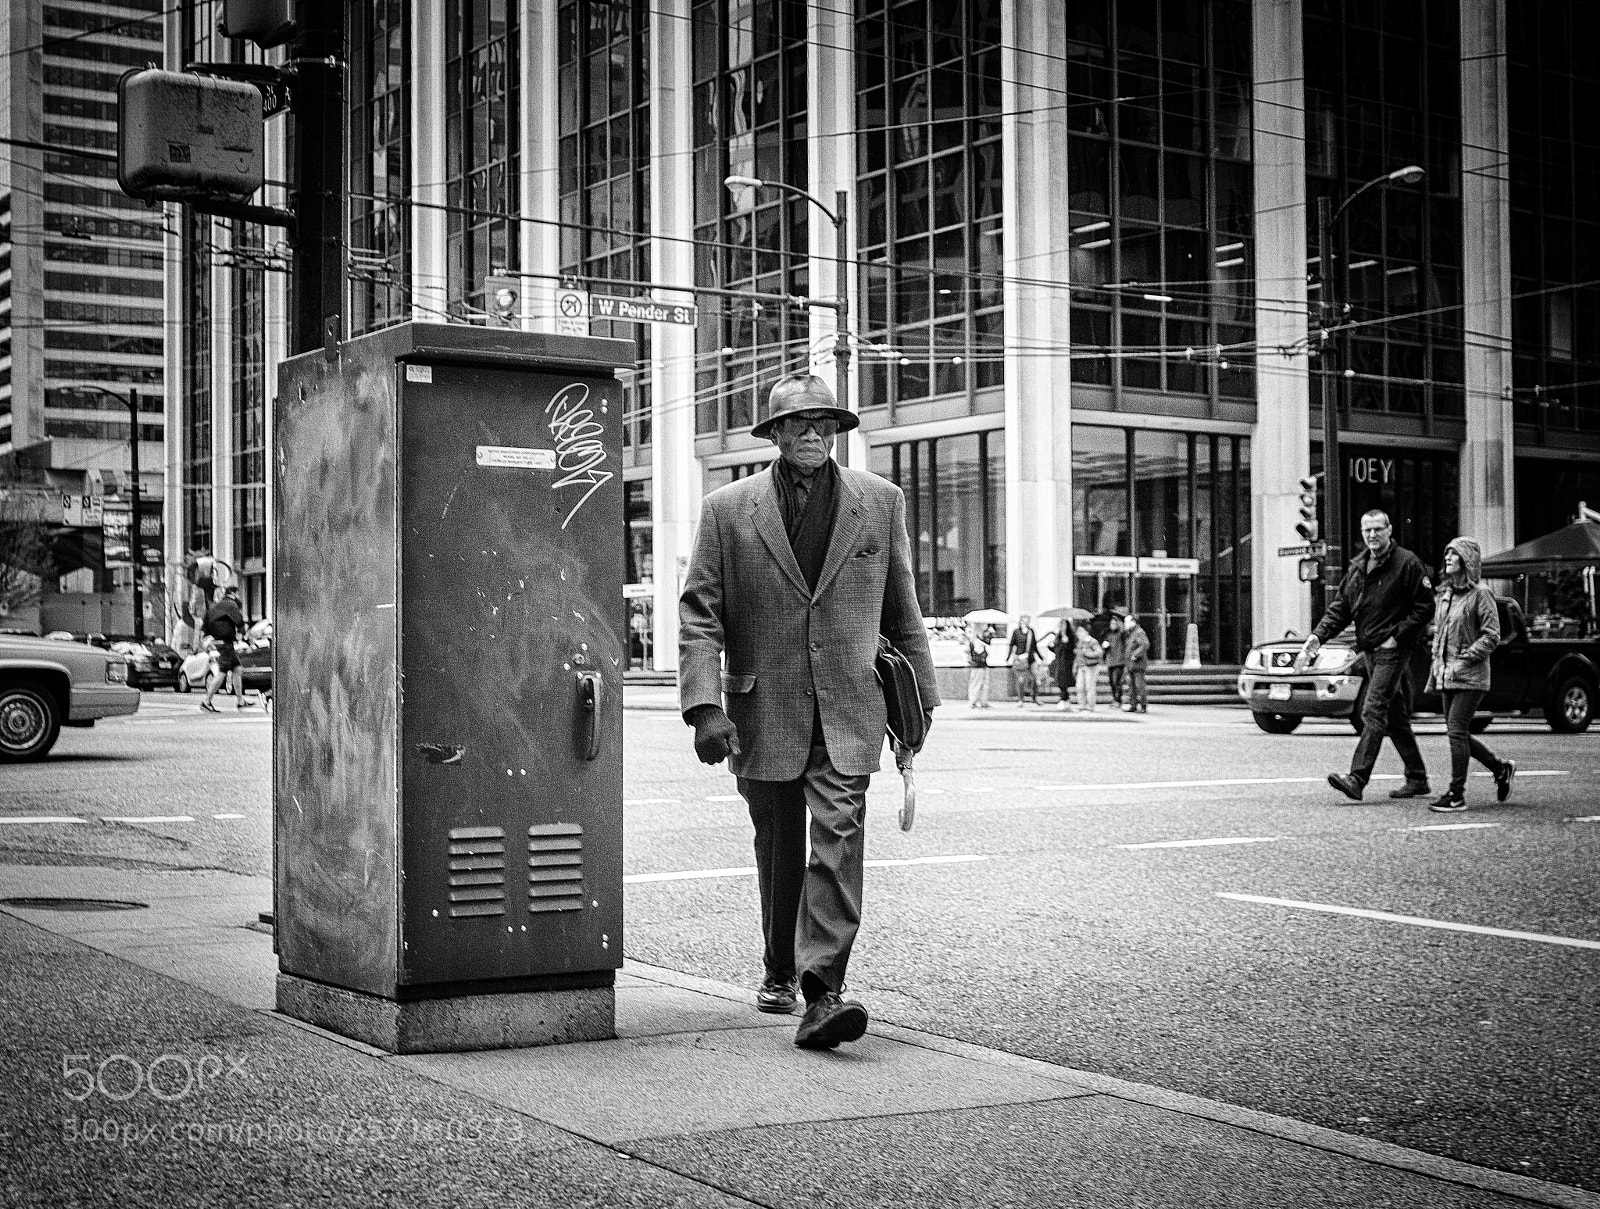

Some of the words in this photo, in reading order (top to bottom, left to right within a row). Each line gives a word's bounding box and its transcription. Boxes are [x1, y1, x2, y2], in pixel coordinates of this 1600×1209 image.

[598, 298, 615, 316] W
[618, 301, 670, 321] Pender
[673, 306, 690, 324] St
